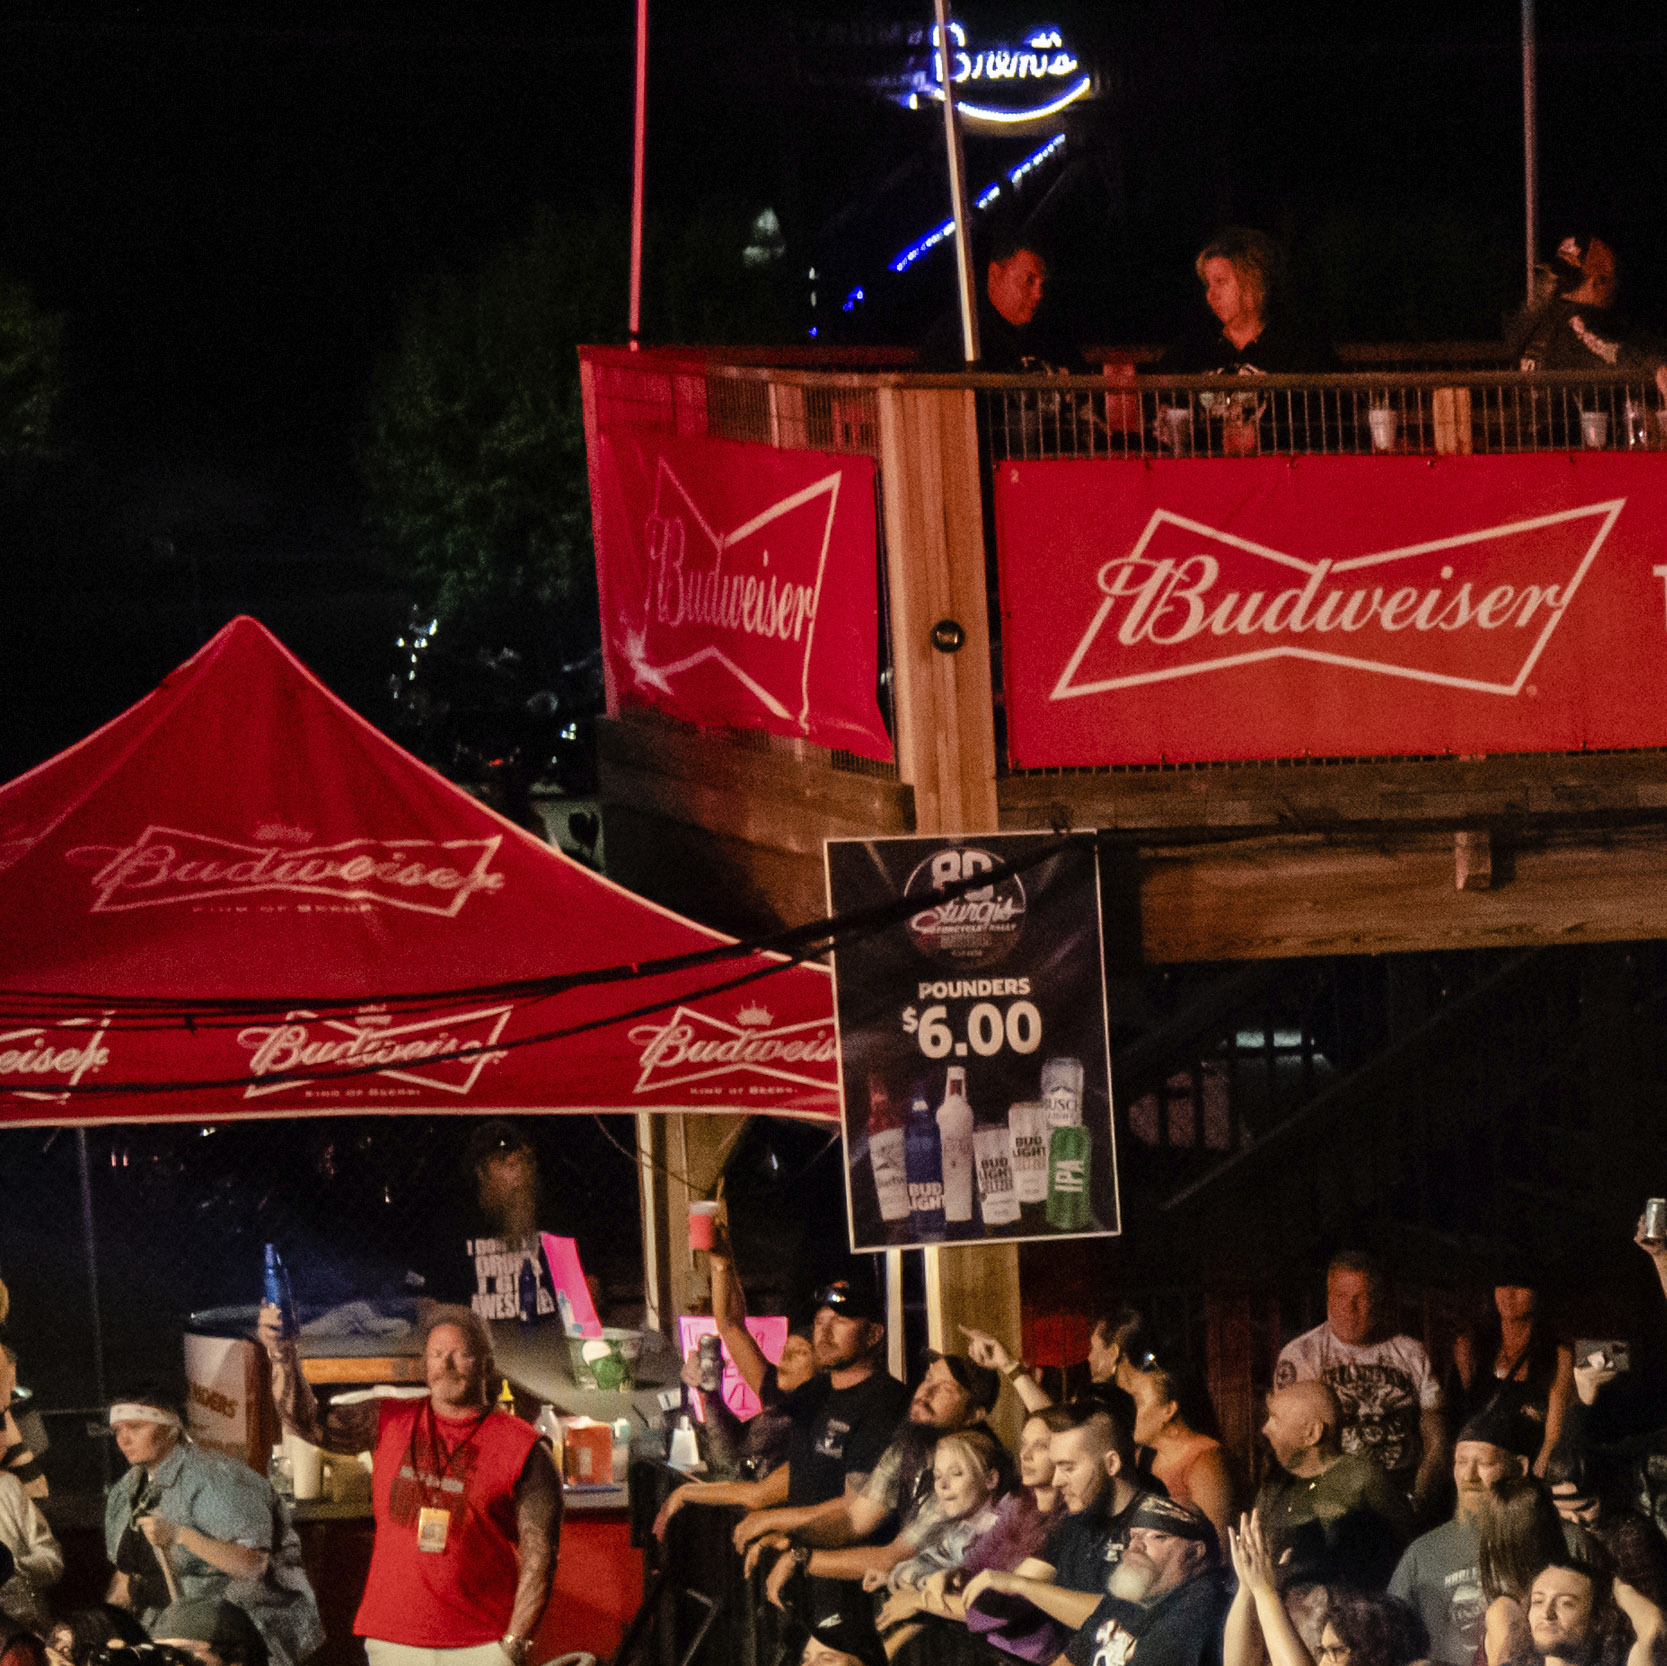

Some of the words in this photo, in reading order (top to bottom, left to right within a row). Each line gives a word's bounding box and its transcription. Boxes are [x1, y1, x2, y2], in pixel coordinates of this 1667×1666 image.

[644, 515, 818, 642] Budweiser
[1098, 554, 1566, 647] Budweiser
[65, 843, 506, 893] Budweiser
[917, 976, 1032, 1001] POUNDERS
[236, 1024, 510, 1076] Budweiser
[627, 1023, 837, 1070] Budweis
[901, 1000, 1043, 1060] $6.00
[0, 1036, 111, 1075] eiser
[908, 1182, 943, 1197] BUD
[1054, 1159, 1084, 1193] IPA
